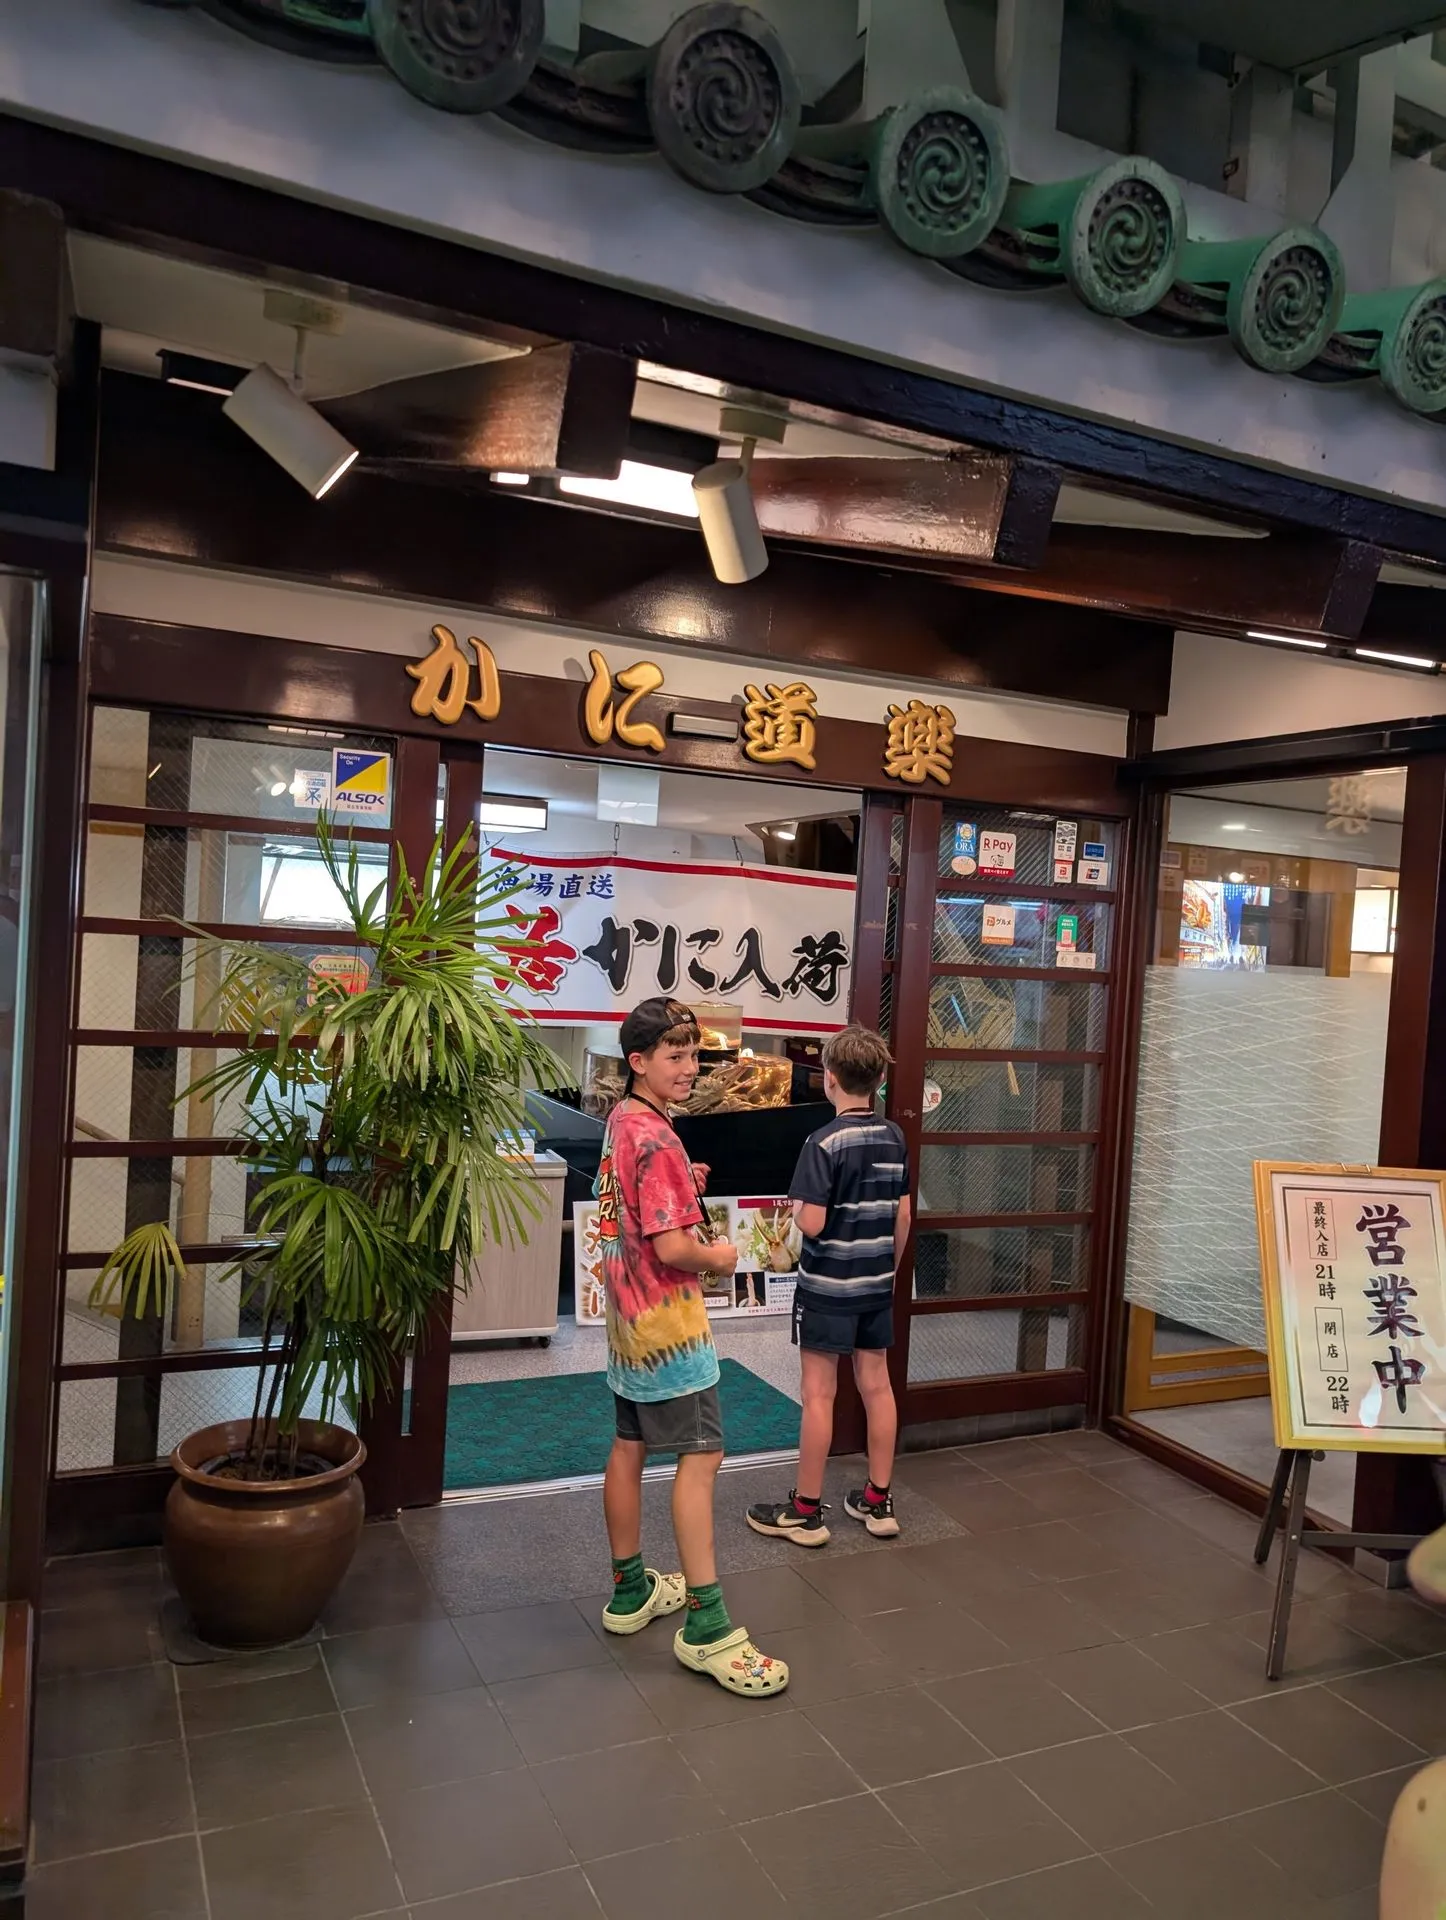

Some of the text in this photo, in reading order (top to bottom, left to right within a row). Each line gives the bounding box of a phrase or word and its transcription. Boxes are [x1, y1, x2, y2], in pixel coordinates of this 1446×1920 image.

[339, 754, 361, 762] Security
[335, 791, 385, 806] ALSOK
[955, 841, 974, 852] ORA
[494, 867, 616, 899] 漁場直送
[1313, 1201, 1329, 1257] 最終入店
[1355, 1203, 1426, 1415] 営業中
[1323, 1321, 1339, 1359] 閉店
